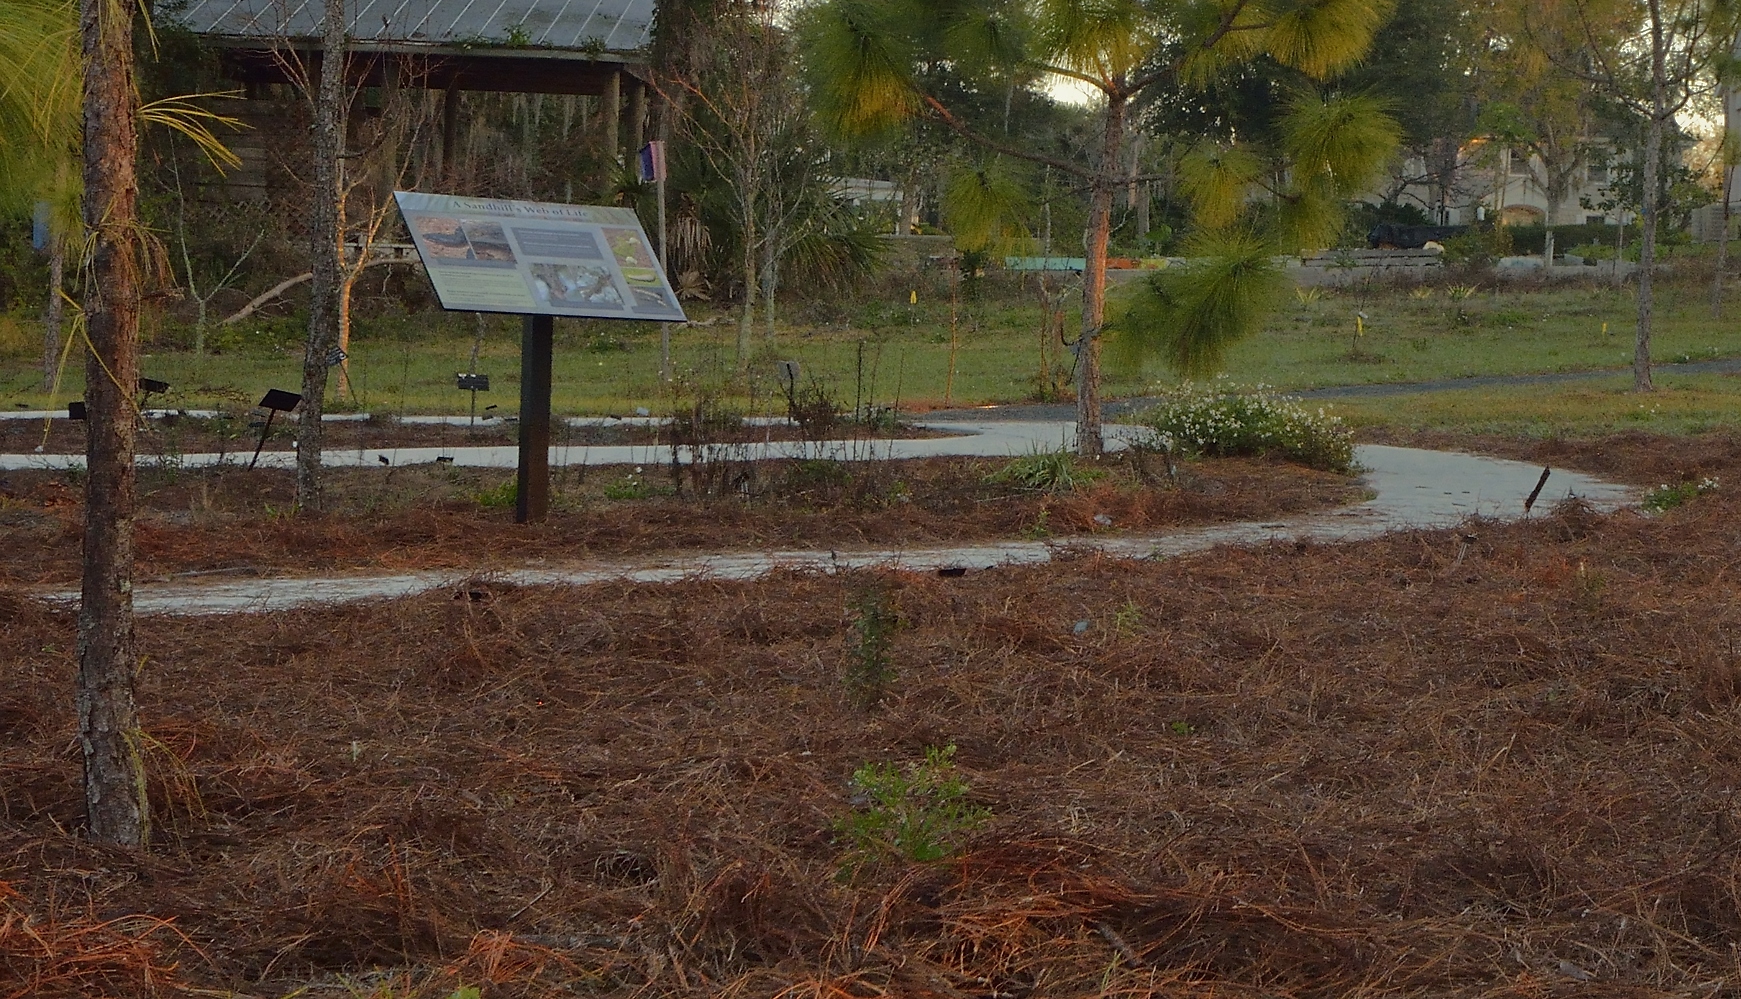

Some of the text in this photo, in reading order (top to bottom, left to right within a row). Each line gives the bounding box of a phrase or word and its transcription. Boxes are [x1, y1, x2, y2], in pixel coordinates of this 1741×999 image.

[452, 200, 461, 208] A
[463, 201, 521, 213] Sandhill's
[523, 205, 549, 215] Web
[566, 208, 589, 217] Life
